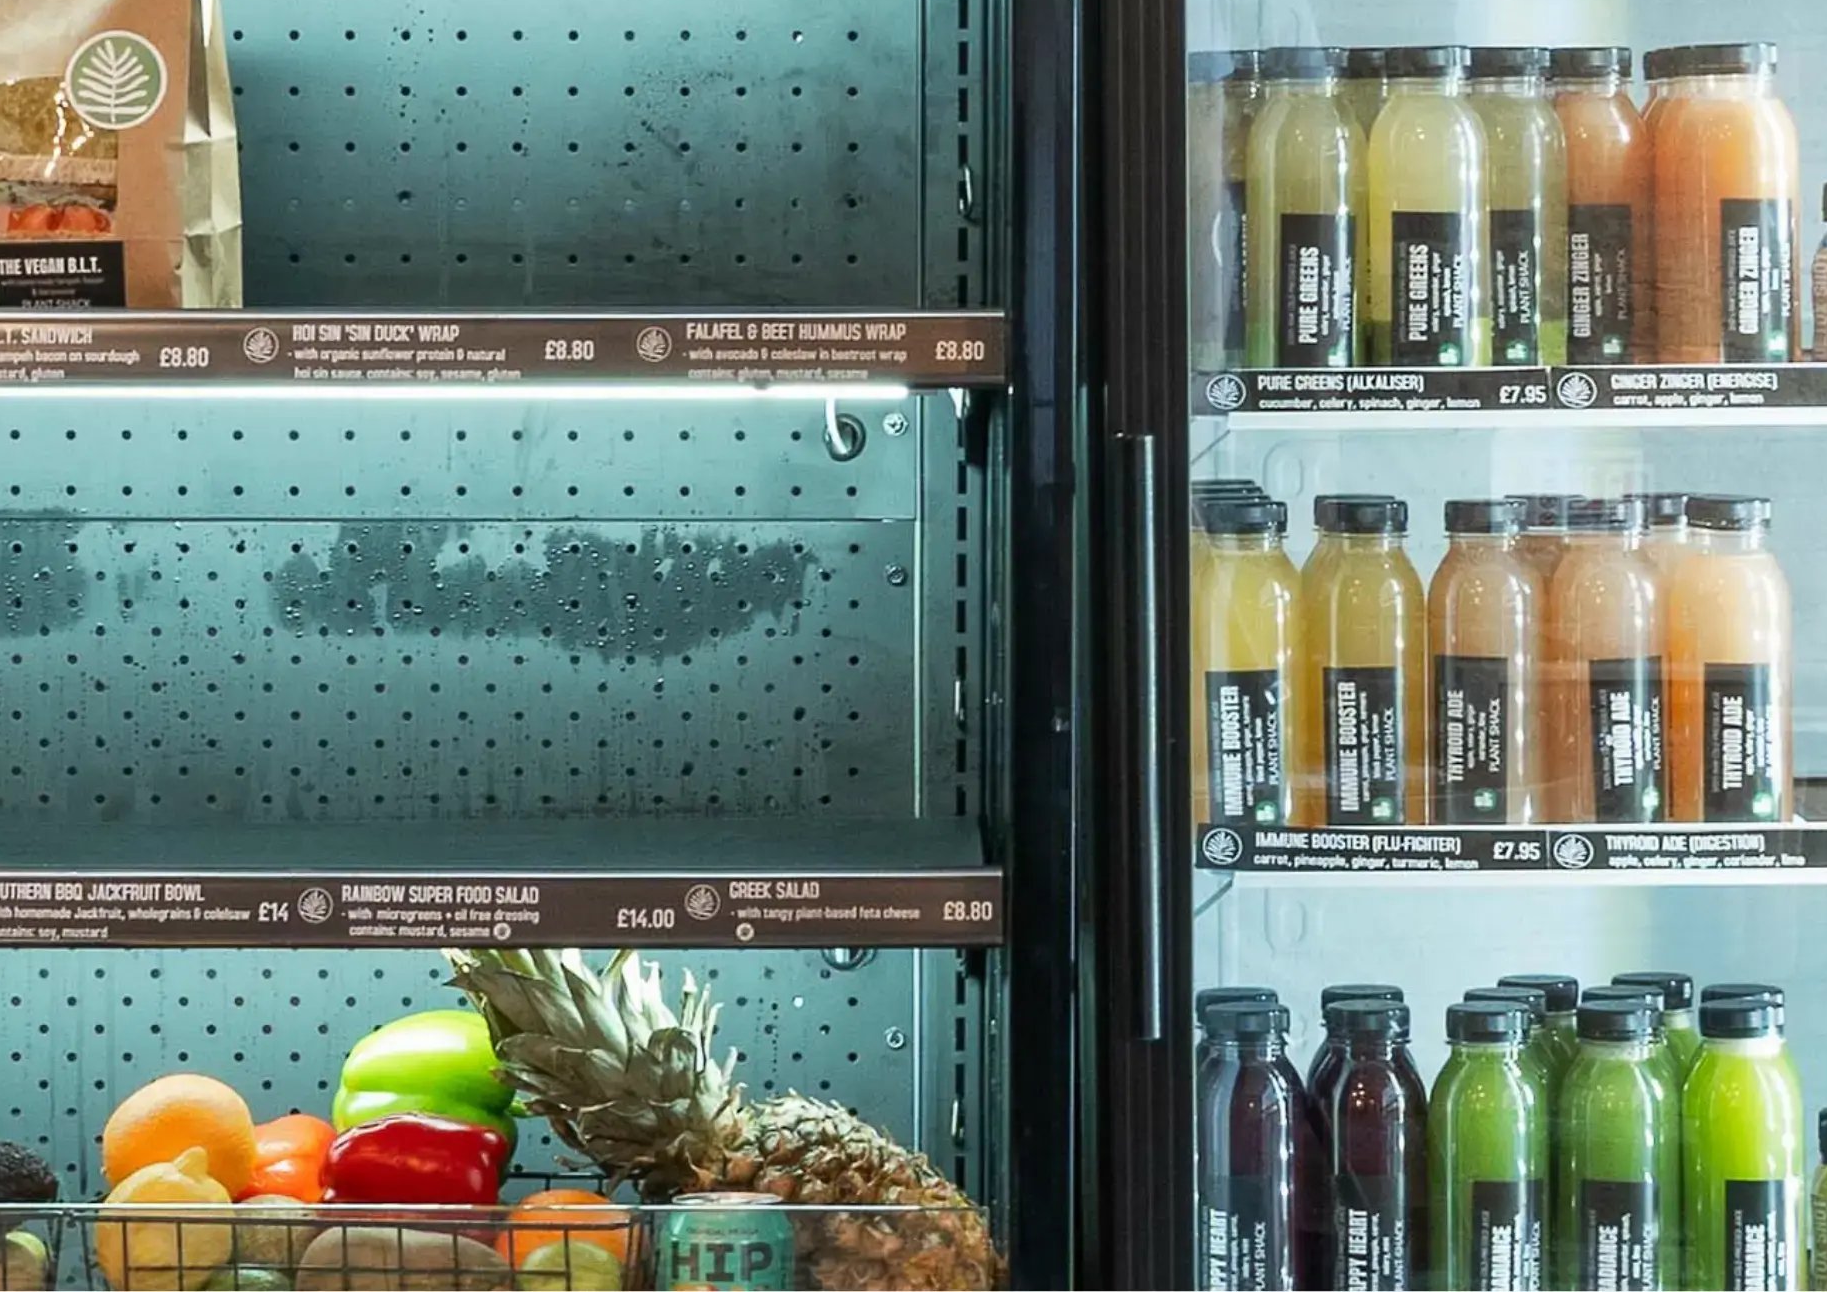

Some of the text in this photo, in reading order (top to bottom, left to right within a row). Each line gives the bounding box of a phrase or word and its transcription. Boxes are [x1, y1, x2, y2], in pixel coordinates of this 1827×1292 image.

[24, 258, 63, 274] VEGAN
[67, 257, 102, 274] B.L.T.
[1409, 245, 1429, 342] PURE GREENS
[1573, 234, 1592, 338] GINGER ZINGER
[293, 325, 315, 341] HOI
[319, 325, 341, 341] SIN
[418, 325, 459, 341] WRAP
[687, 323, 906, 340] FALAFEL & BEET HUMMUS WRAP
[545, 340, 594, 359] £8.80
[935, 341, 984, 360] £8.80
[1258, 375, 1424, 393] PURE GREENS (ALKALISER)
[1500, 386, 1545, 403] £7.95
[1447, 690, 1464, 783] THYROID ADE
[1256, 833, 1460, 855] IMMUNE BOOSTER (FLU-FIGHTER)
[1494, 842, 1540, 860] £7.95
[342, 885, 539, 904] RAINBOW SUPER FOOD SALAD
[729, 882, 819, 899] GREEK SALAD
[617, 909, 674, 928] £14.00
[944, 901, 992, 921] £8.80
[669, 1242, 773, 1282] HIP
